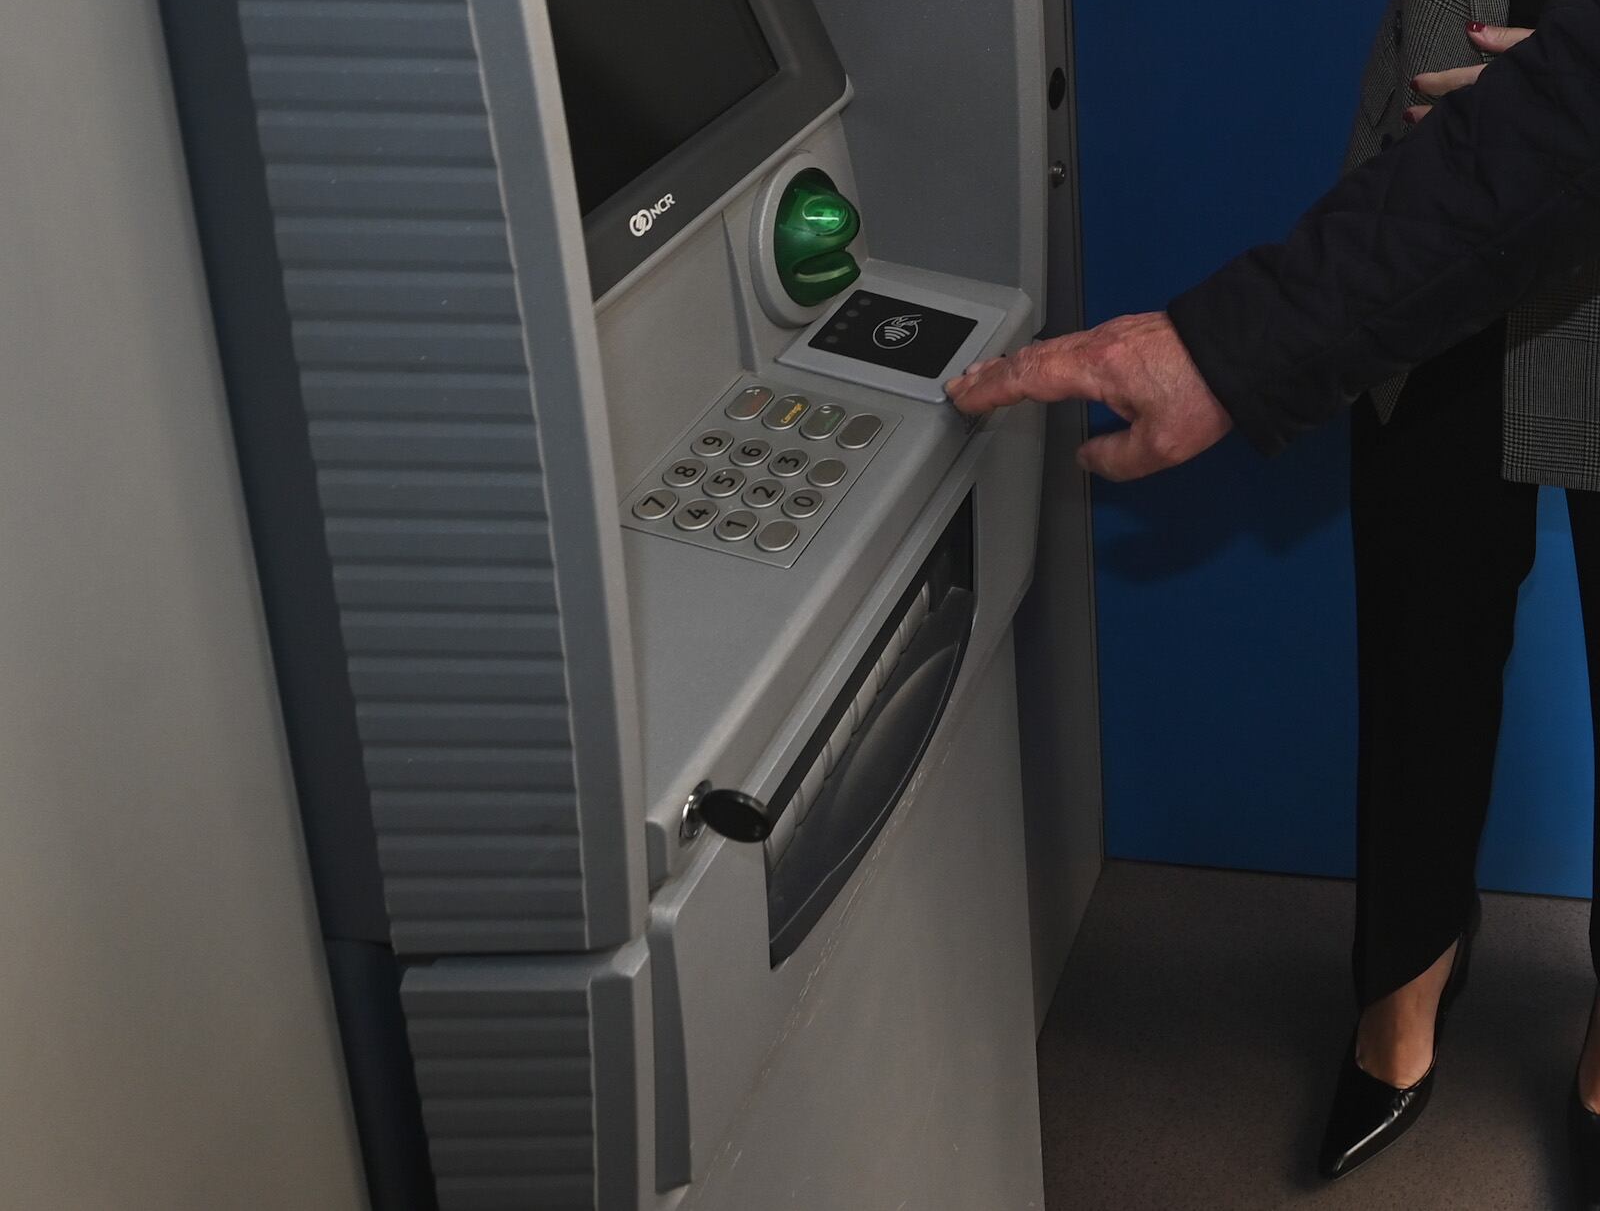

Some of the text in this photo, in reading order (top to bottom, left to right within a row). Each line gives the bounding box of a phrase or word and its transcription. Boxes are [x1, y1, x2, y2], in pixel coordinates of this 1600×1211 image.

[650, 193, 676, 219] NCR
[703, 436, 723, 447] 9
[741, 446, 761, 457] 6
[778, 456, 799, 468] 3
[674, 466, 696, 478] 8
[713, 475, 735, 487] 5
[752, 486, 776, 499] 2
[642, 497, 666, 510] 7
[793, 496, 814, 507] 0
[687, 507, 710, 520] 4
[726, 520, 748, 529] 1
